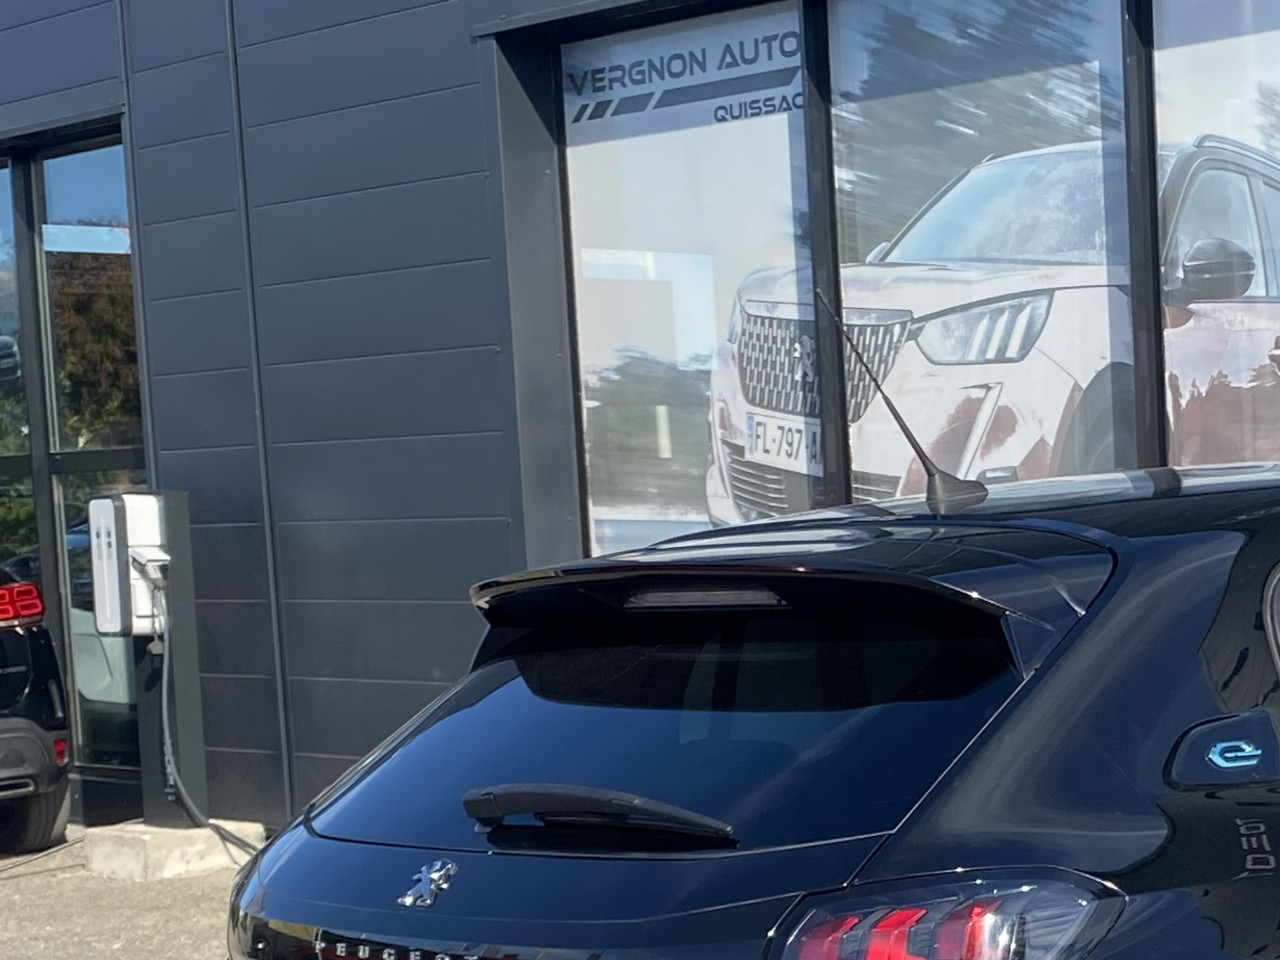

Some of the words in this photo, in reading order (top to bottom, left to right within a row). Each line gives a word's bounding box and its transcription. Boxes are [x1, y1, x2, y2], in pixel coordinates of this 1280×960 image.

[568, 48, 707, 96] VERGNON
[717, 31, 801, 70] AUTO
[714, 92, 803, 122] QUISSAC
